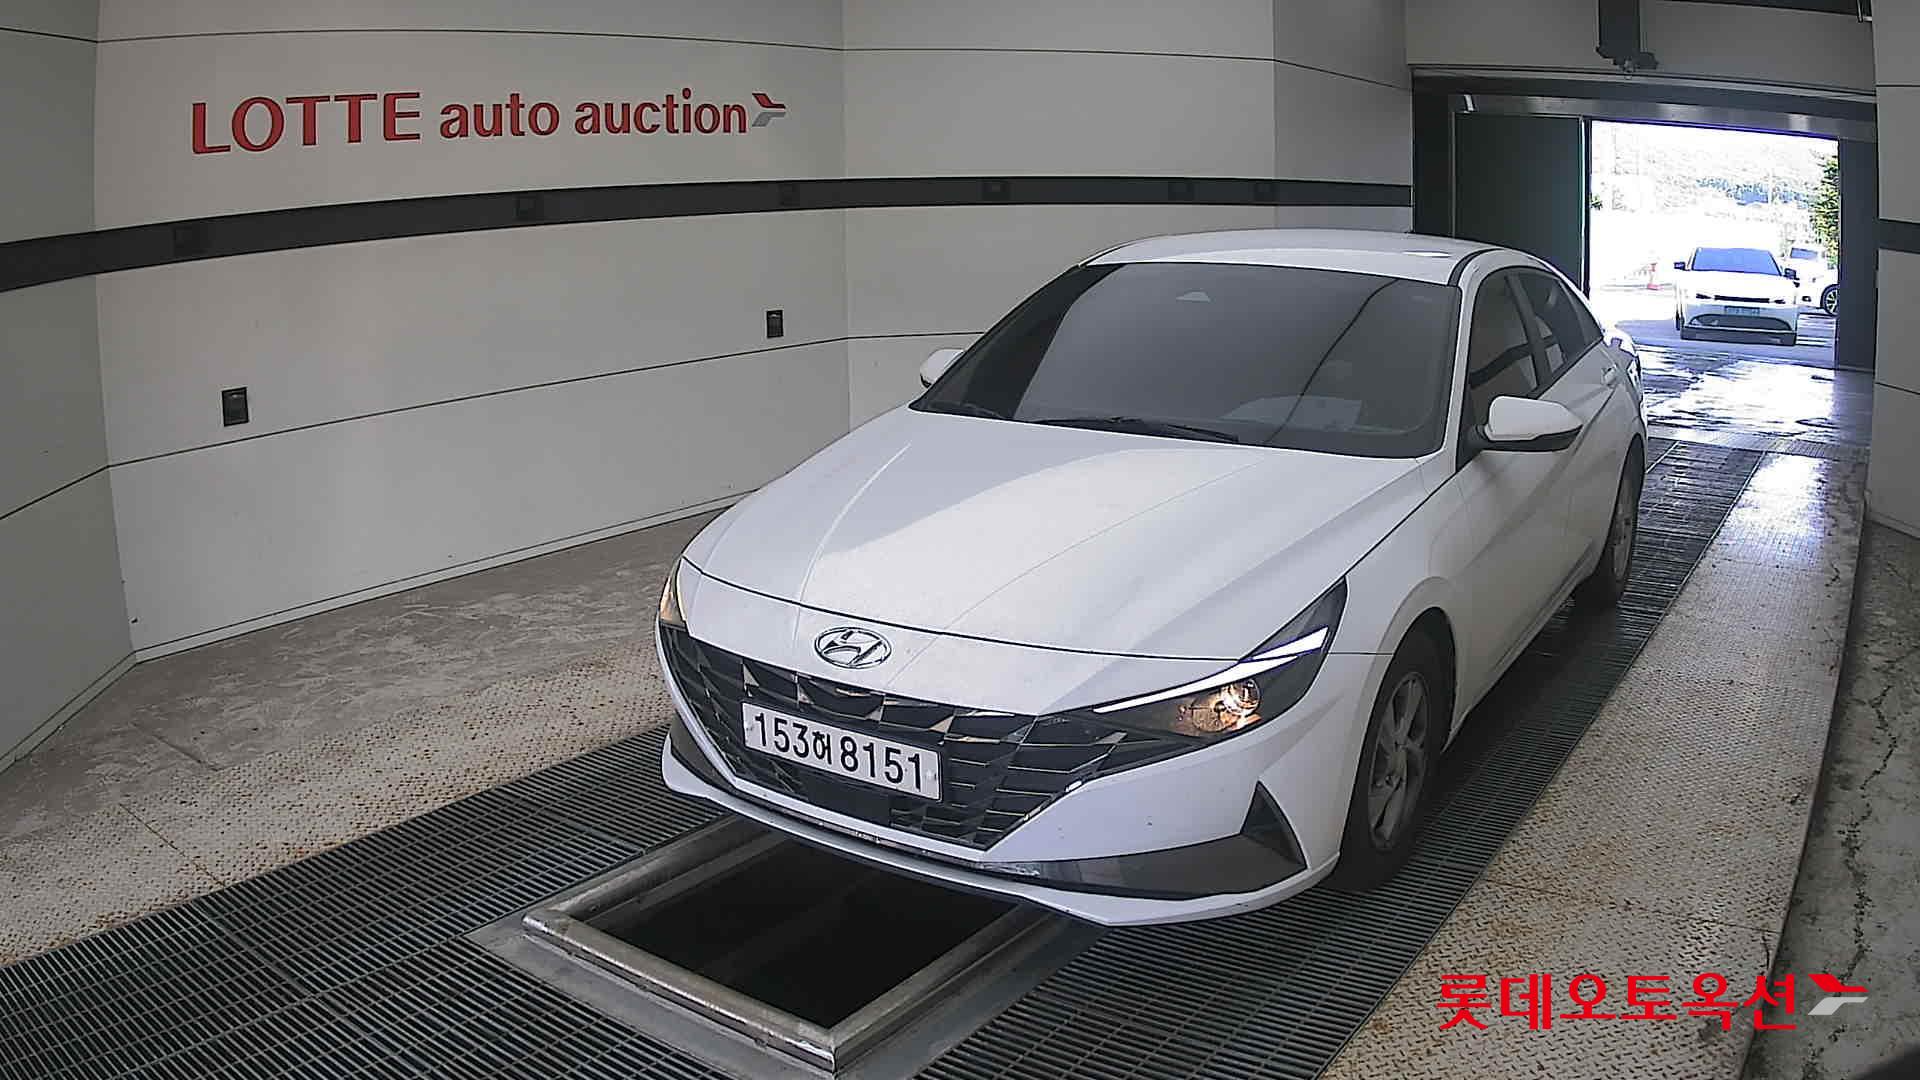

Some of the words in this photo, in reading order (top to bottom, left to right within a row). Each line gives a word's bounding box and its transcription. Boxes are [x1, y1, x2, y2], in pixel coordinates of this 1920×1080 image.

[191, 92, 421, 154] LOTTE
[439, 91, 561, 137] auto
[574, 87, 748, 134] auction
[840, 736, 922, 792] 8151
